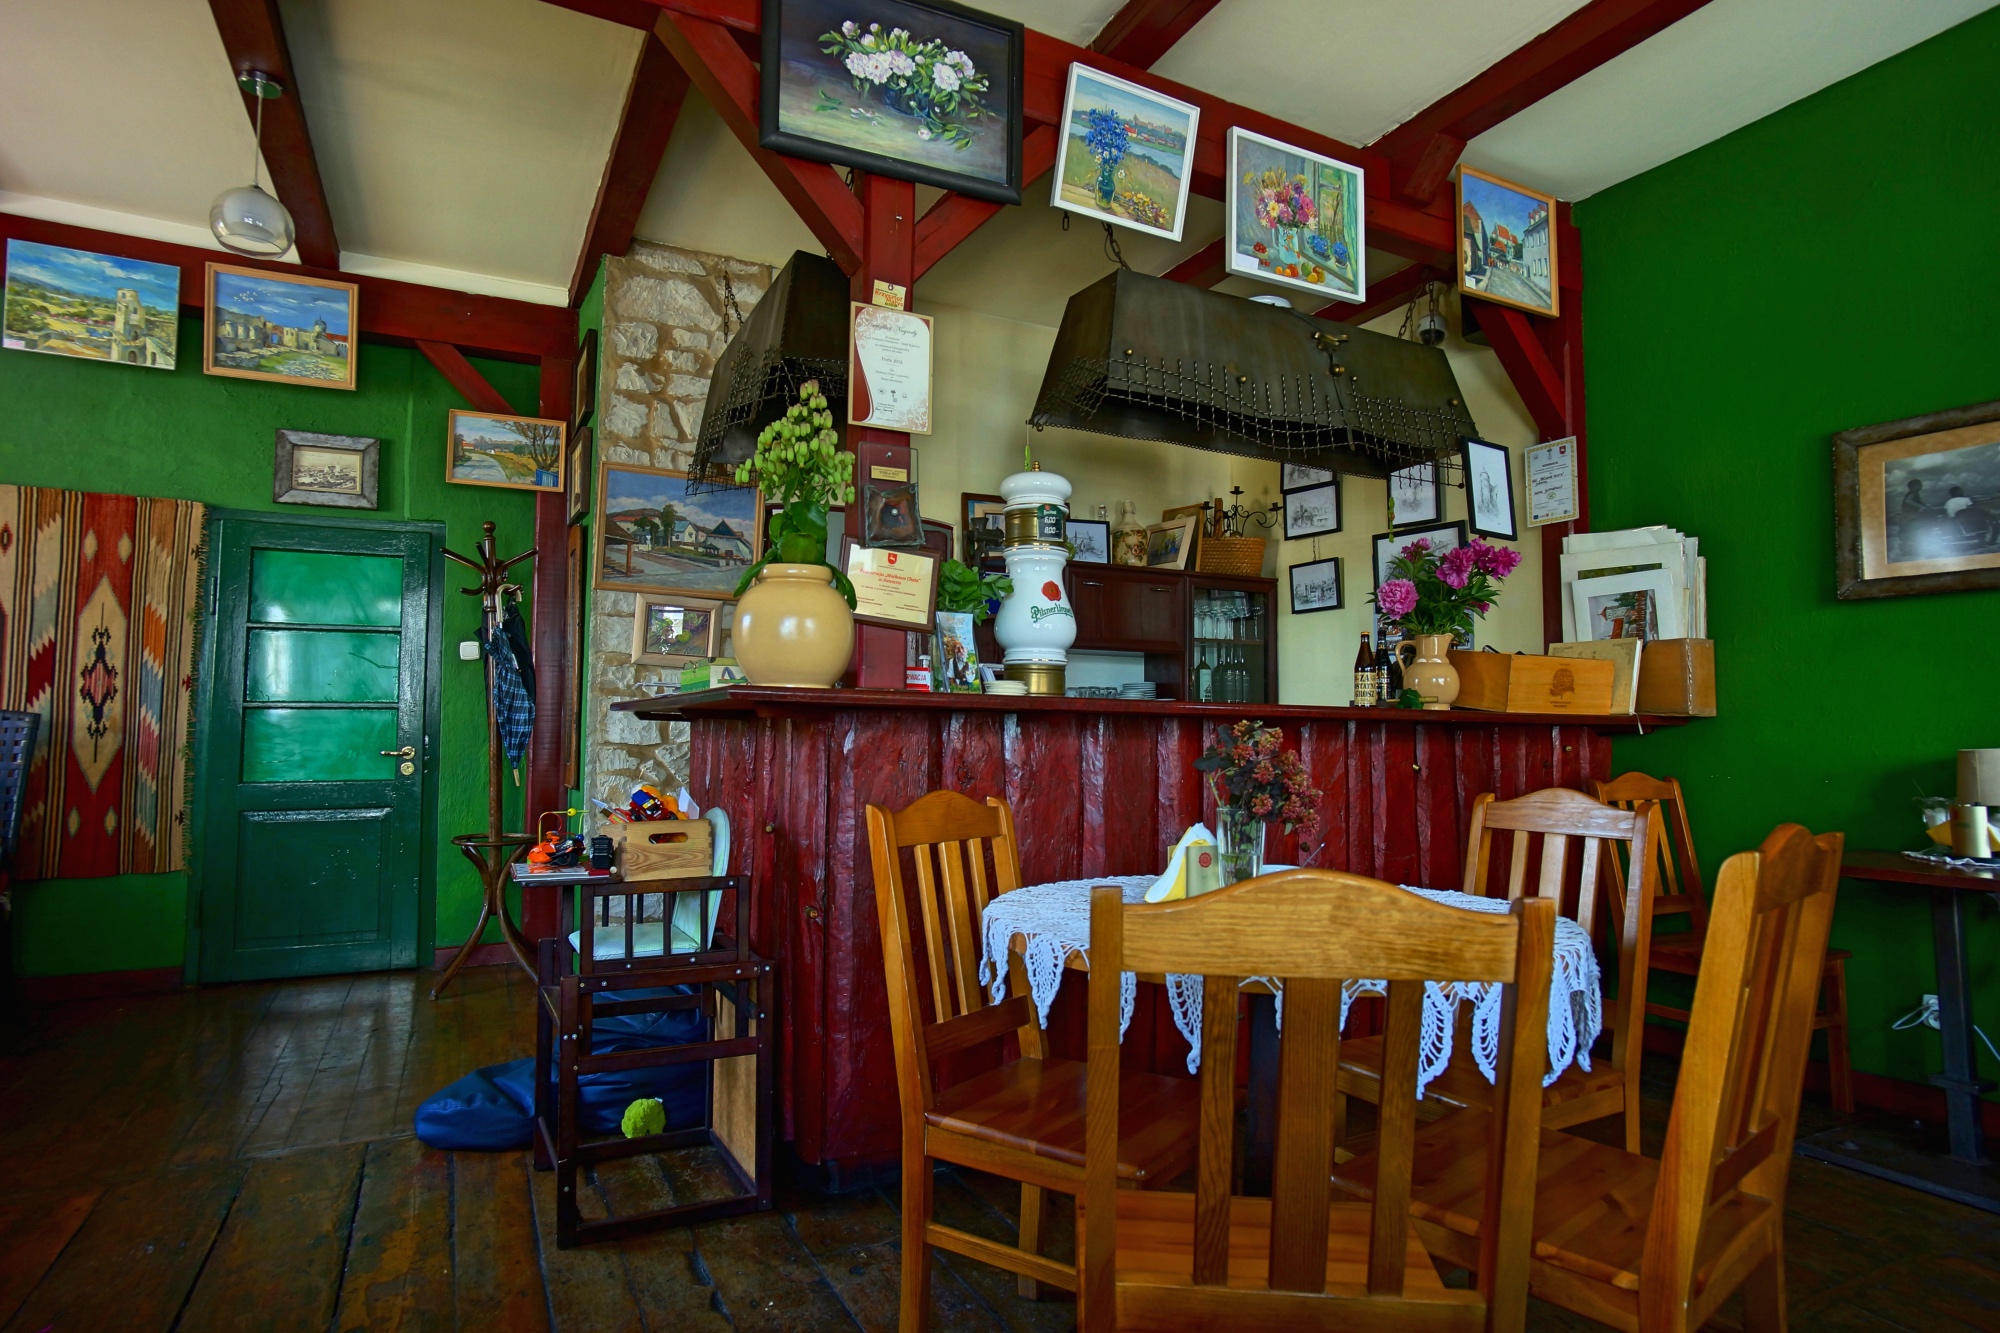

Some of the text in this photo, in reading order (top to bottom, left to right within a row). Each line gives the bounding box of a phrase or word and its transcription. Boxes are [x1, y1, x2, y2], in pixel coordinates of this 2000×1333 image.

[874, 289, 903, 302] Krzysztof
[1359, 674, 1370, 682] ZA
[1355, 690, 1375, 698] GROSZ
